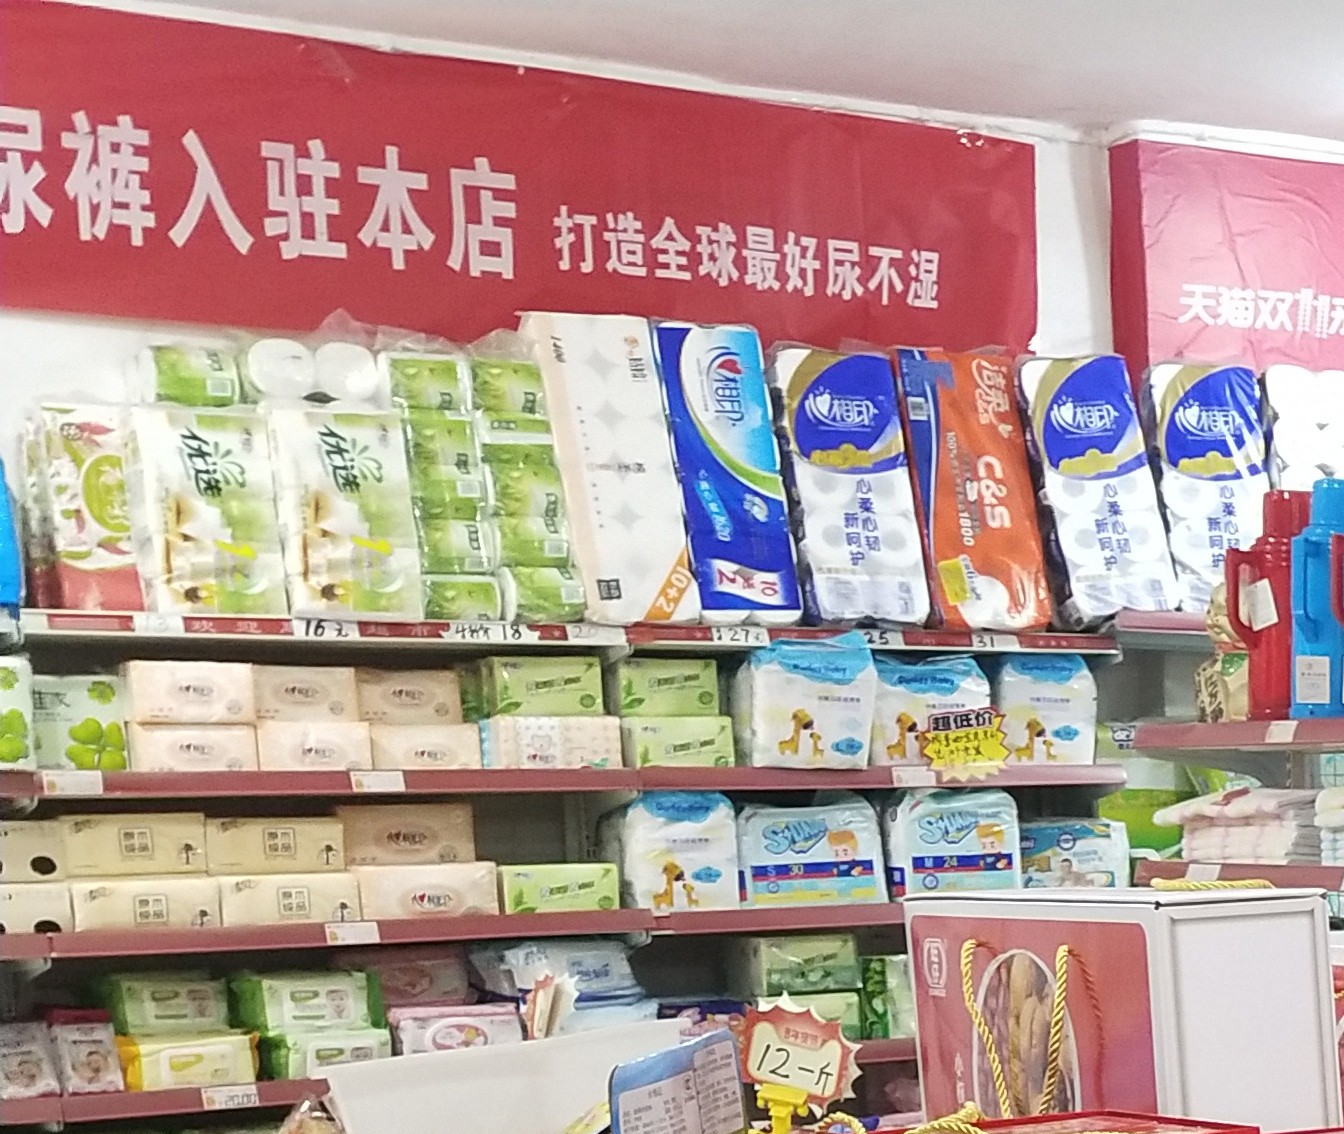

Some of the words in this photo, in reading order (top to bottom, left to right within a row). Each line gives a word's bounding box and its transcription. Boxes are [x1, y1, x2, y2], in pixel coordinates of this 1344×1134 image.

[553, 205, 941, 310] 打造全球最好尿不湿
[932, 710, 994, 732] 超低价
